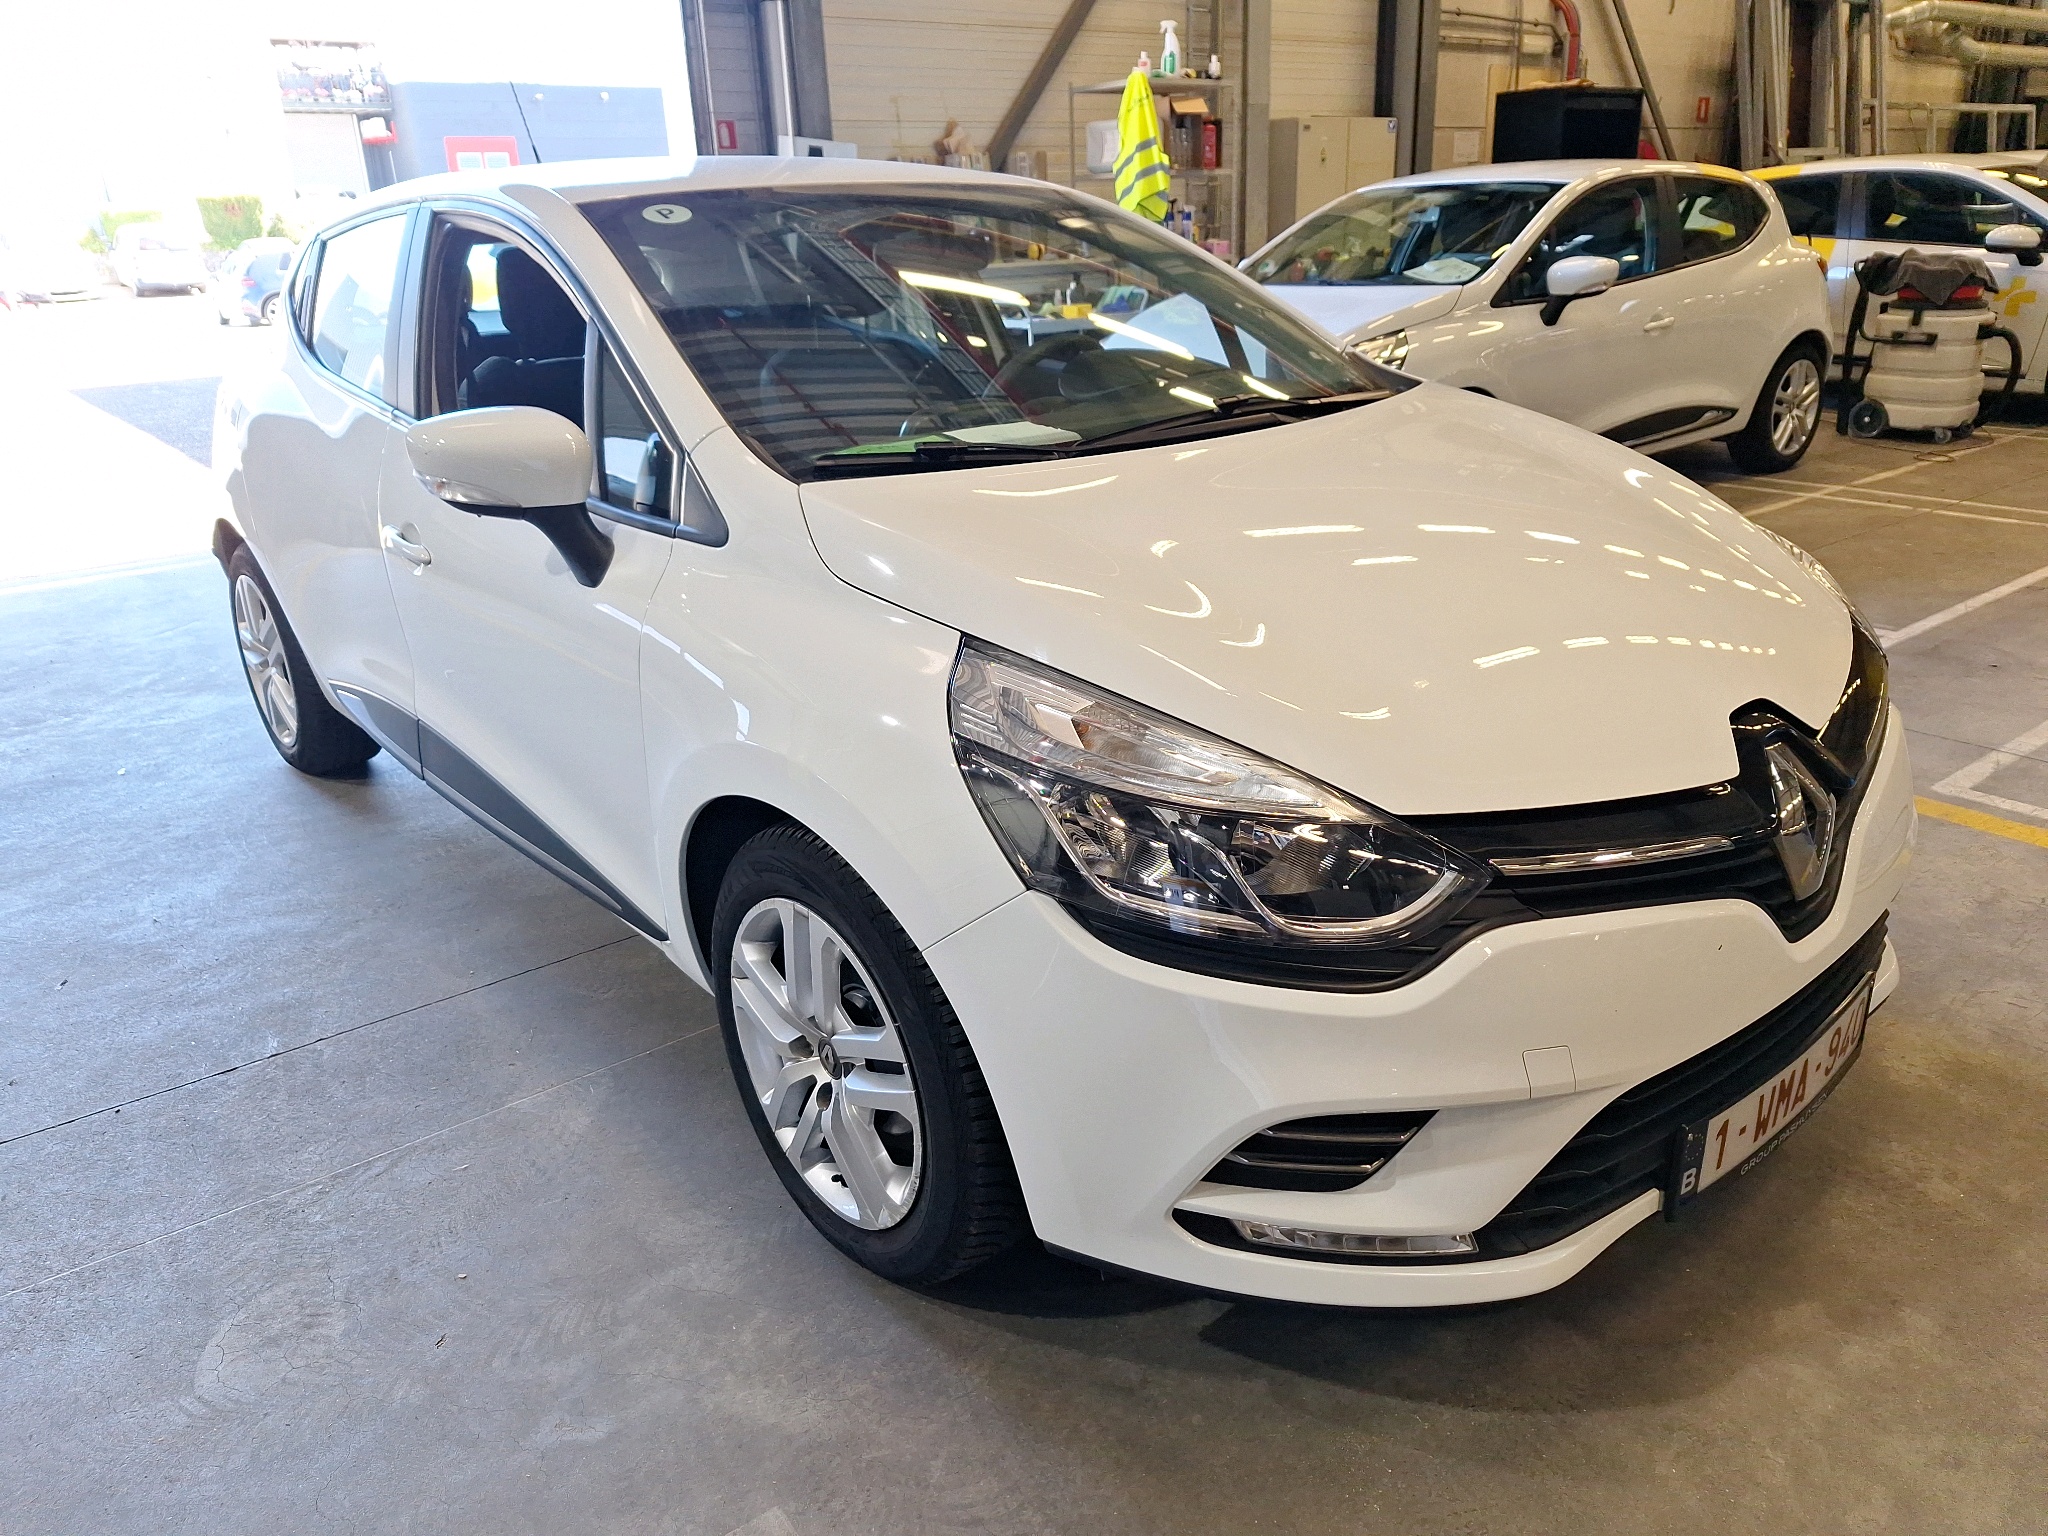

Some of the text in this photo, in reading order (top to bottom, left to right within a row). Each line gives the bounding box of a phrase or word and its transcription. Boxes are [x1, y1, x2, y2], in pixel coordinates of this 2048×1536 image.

[654, 207, 675, 219] P
[1715, 996, 1866, 1171] 1-WMA-940
[1740, 1140, 1778, 1176] GROUP
[1680, 1167, 1697, 1195] B
